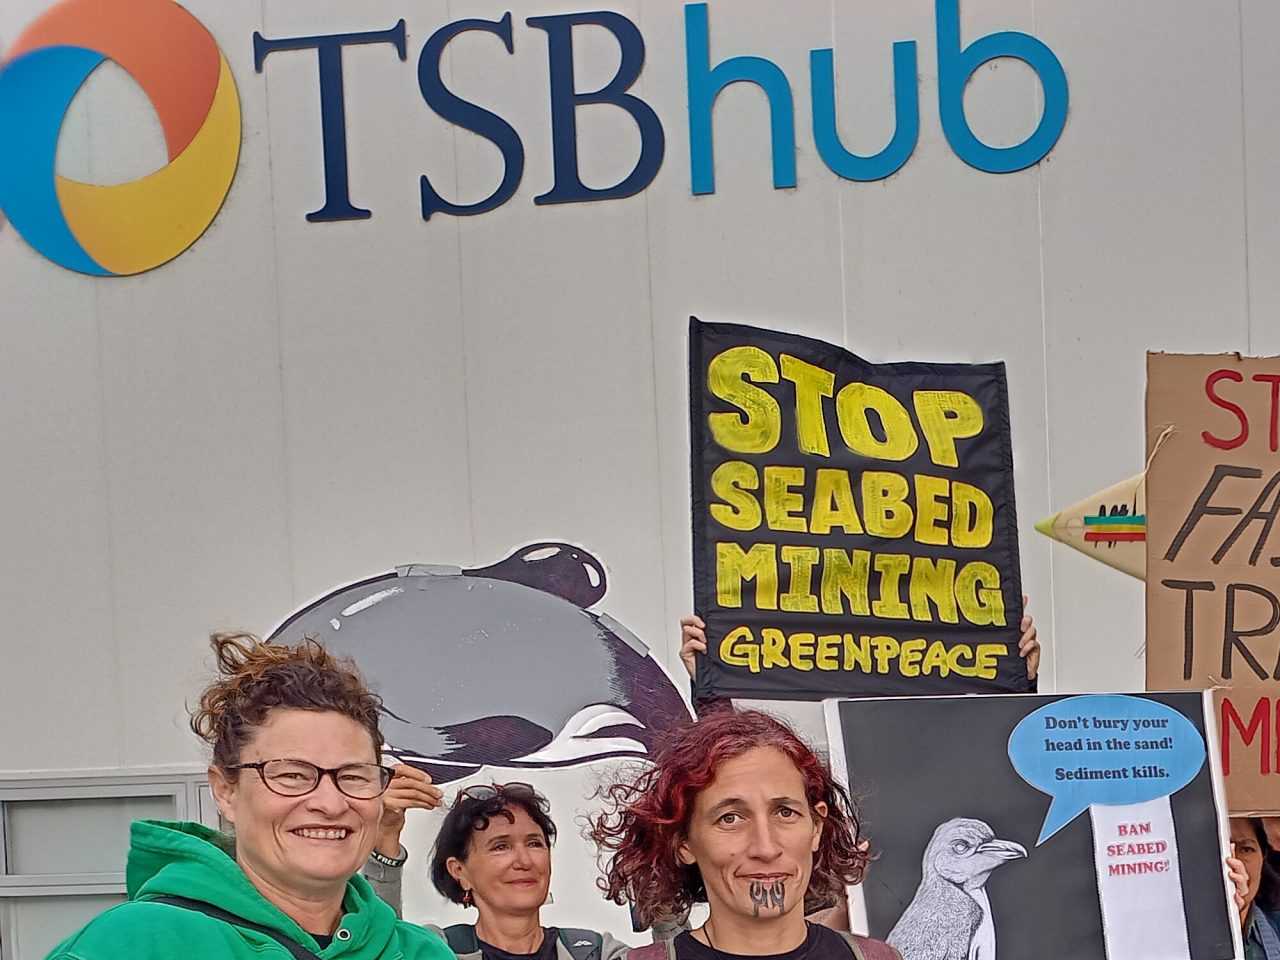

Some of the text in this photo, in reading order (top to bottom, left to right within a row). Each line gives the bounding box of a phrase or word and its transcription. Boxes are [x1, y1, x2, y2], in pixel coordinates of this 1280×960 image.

[708, 346, 984, 468] STOP
[710, 460, 994, 548] SEABED
[716, 542, 1007, 626] MINING
[720, 626, 1008, 680] GREENPEACE
[1045, 716, 1169, 732] Don't bury your
[1044, 737, 1174, 752] head in the sand!
[1055, 766, 1170, 780] Sediment kills.
[1117, 821, 1152, 837] BAN
[1106, 840, 1168, 857] SEABED
[1108, 861, 1170, 876] MINING!
